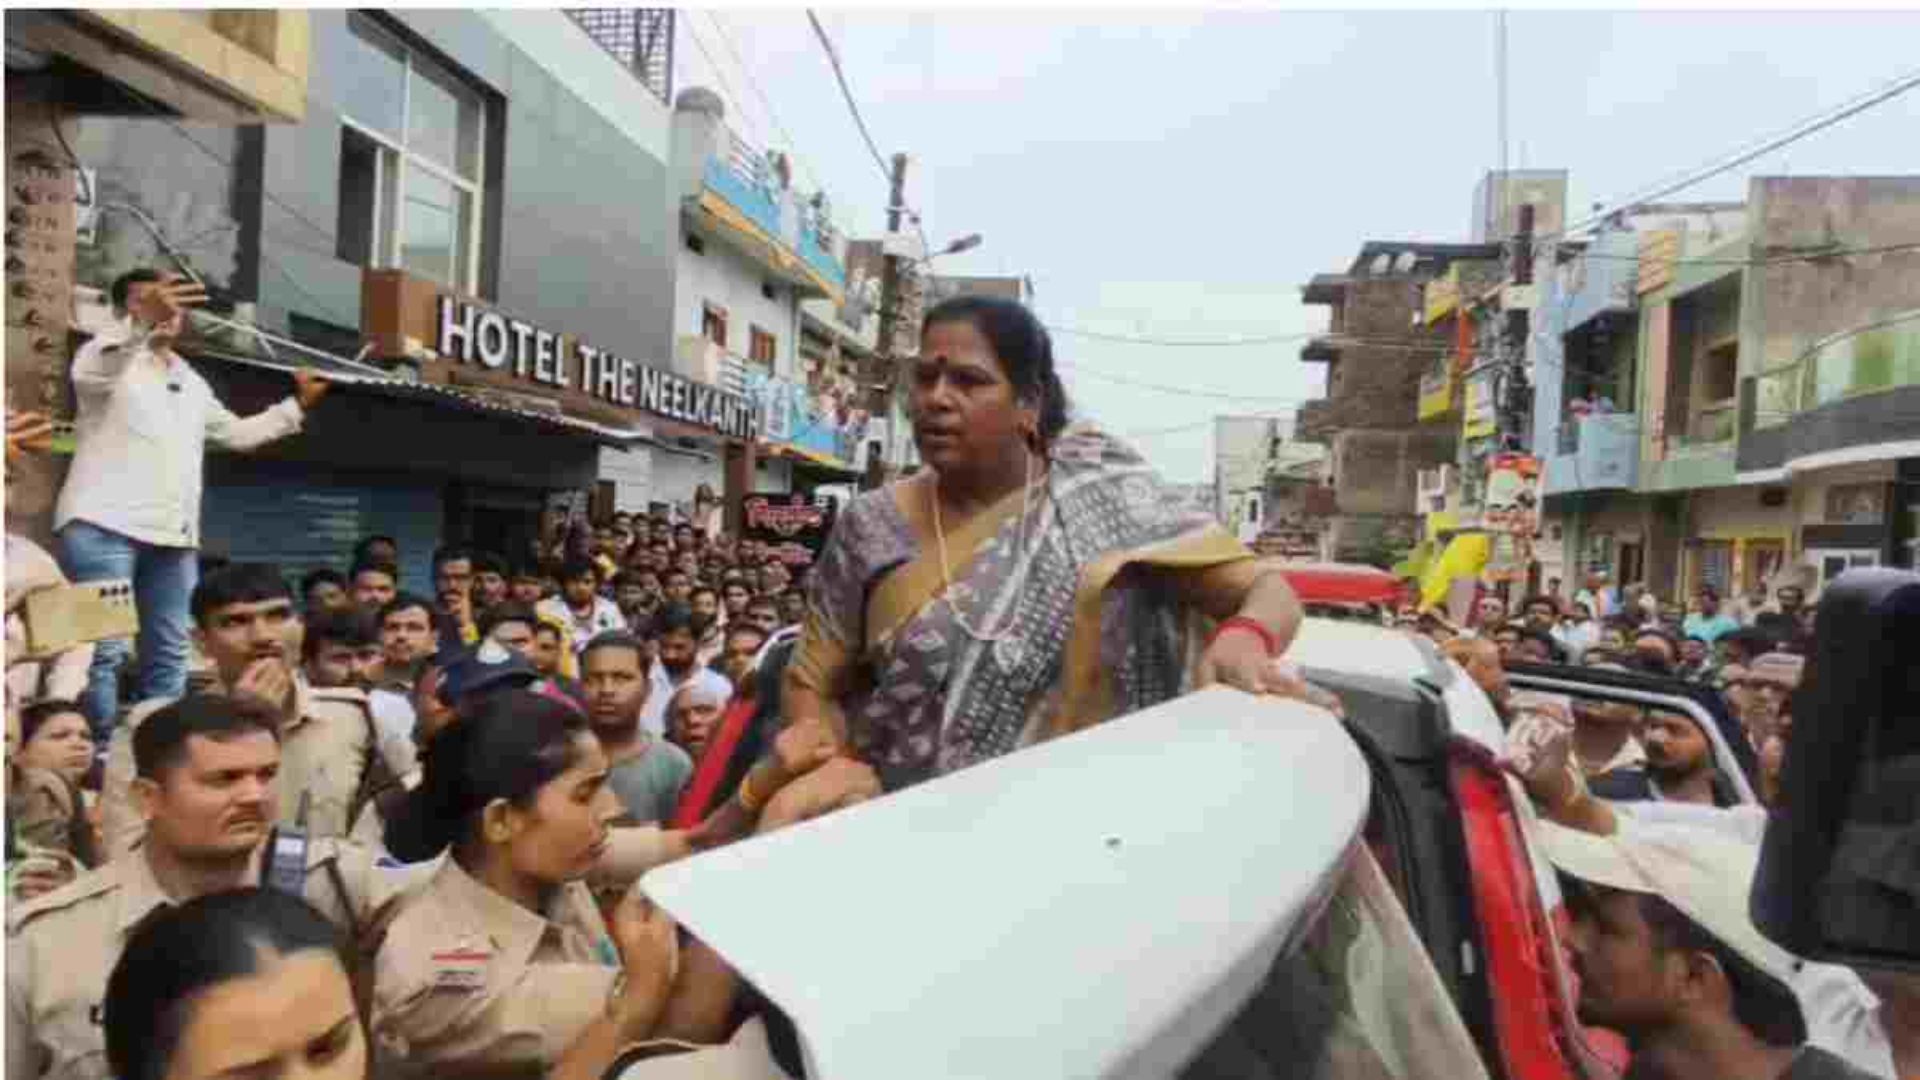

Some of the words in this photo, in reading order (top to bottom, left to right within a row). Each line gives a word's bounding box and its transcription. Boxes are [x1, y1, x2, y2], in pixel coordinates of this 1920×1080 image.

[441, 297, 570, 386] HOTEL
[579, 344, 635, 403] THE
[641, 365, 761, 438] NEELKANTH
